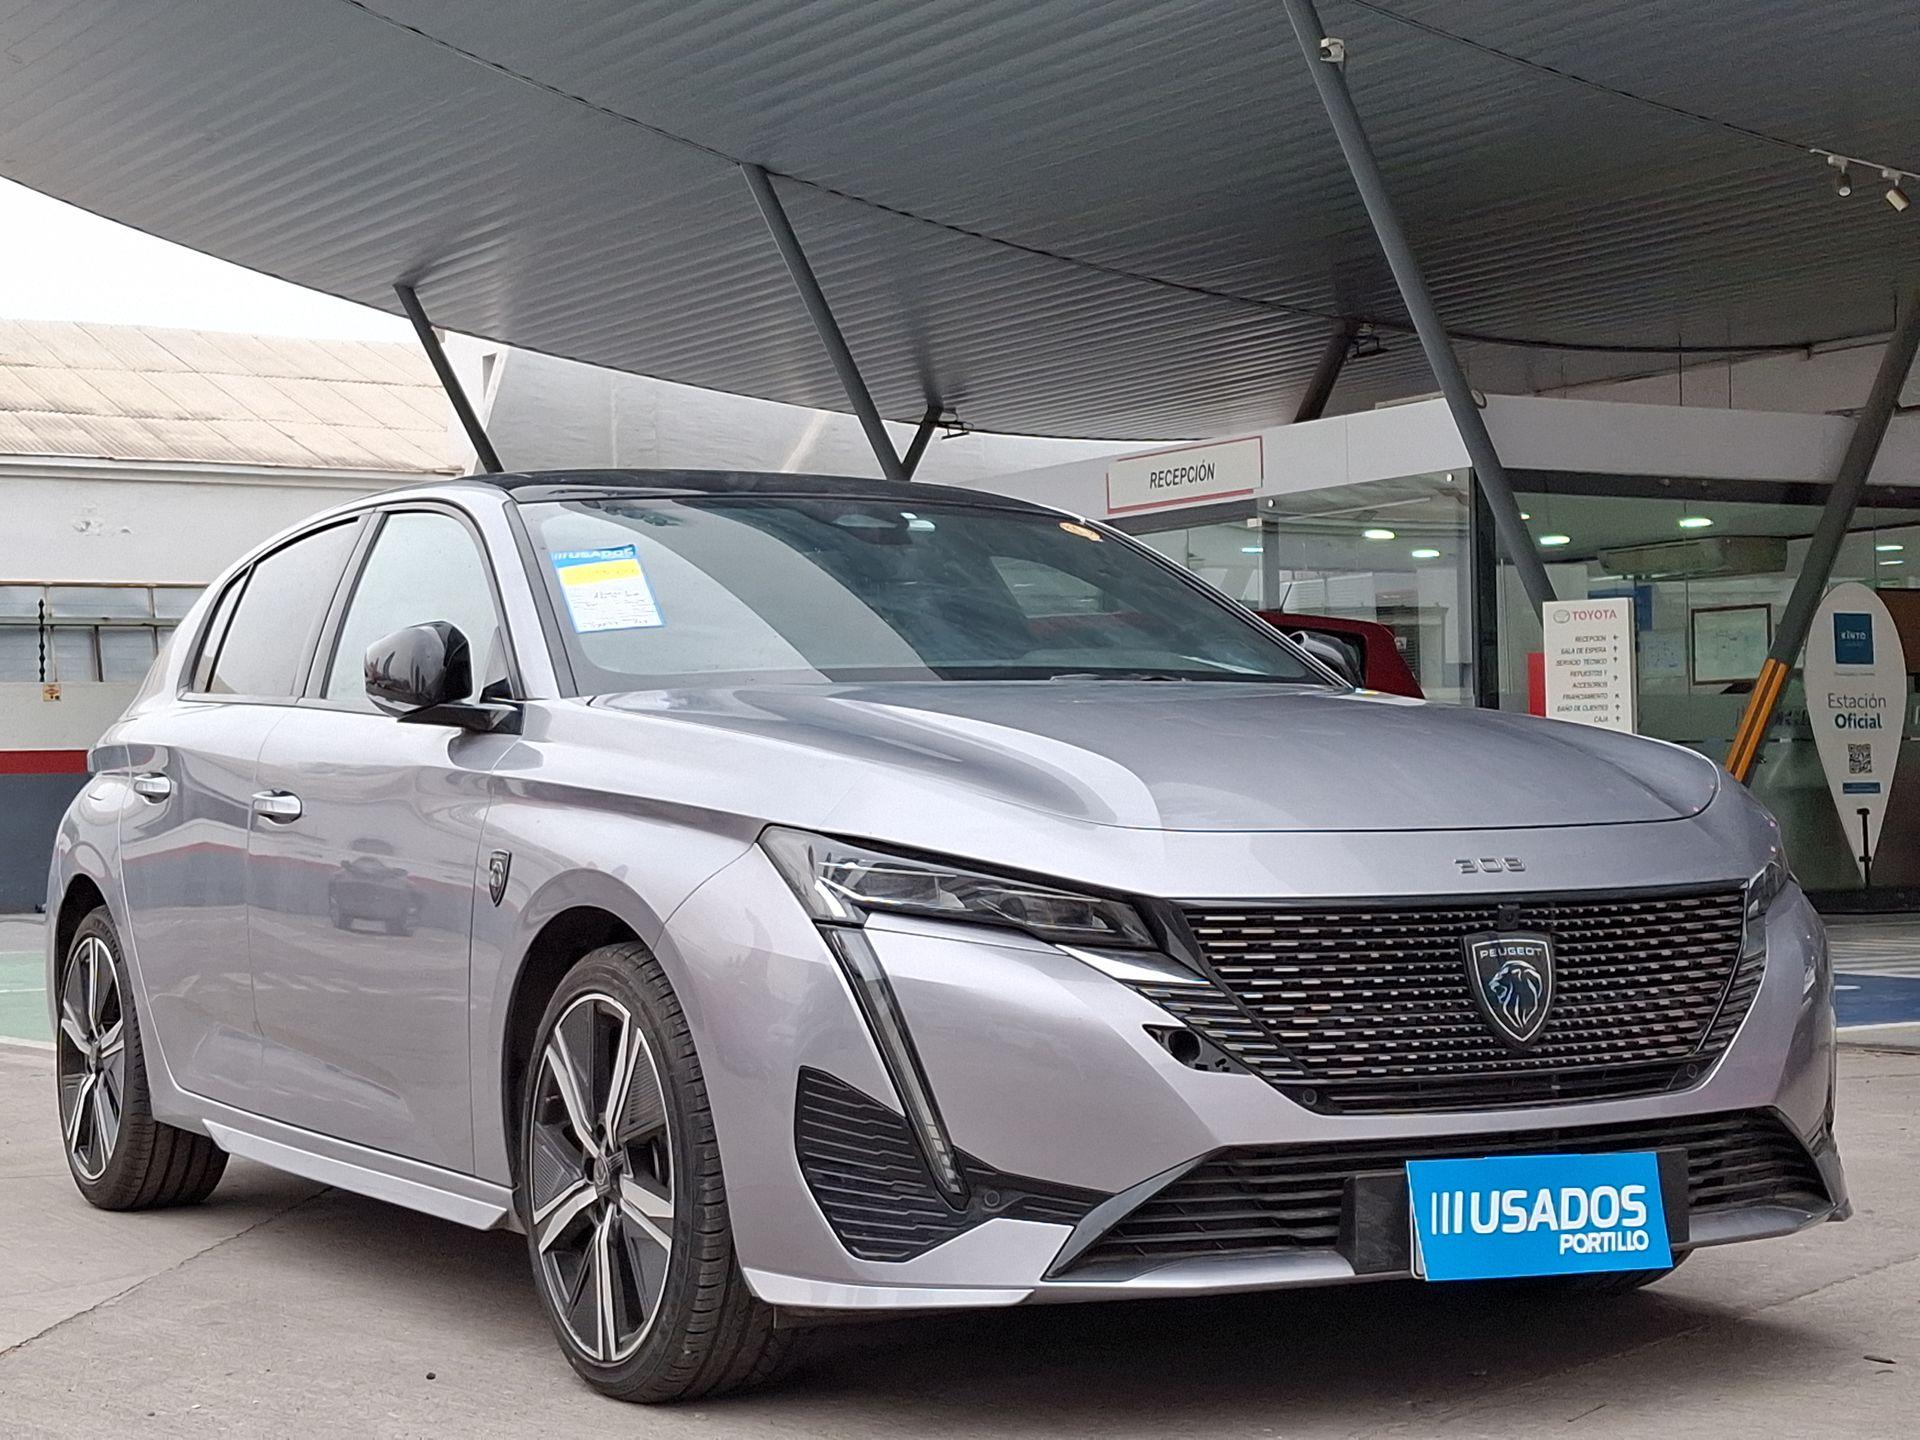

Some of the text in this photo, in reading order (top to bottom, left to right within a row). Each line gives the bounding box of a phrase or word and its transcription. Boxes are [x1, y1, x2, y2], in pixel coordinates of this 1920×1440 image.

[1149, 460, 1216, 489] RECEPCIÓN
[1573, 609, 1617, 620] TOYOTA
[1585, 646, 1607, 654] ESPERA
[1572, 681, 1608, 689] ACCESORIOS
[1827, 692, 1887, 709] Estación
[1594, 716, 1608, 724] CAJA
[1834, 712, 1883, 729] Oficial
[1454, 856, 1527, 874] 308
[1479, 946, 1543, 959] PEUGEOT
[1470, 1184, 1647, 1234] USADOS
[1559, 1230, 1650, 1256] PORTILLO
